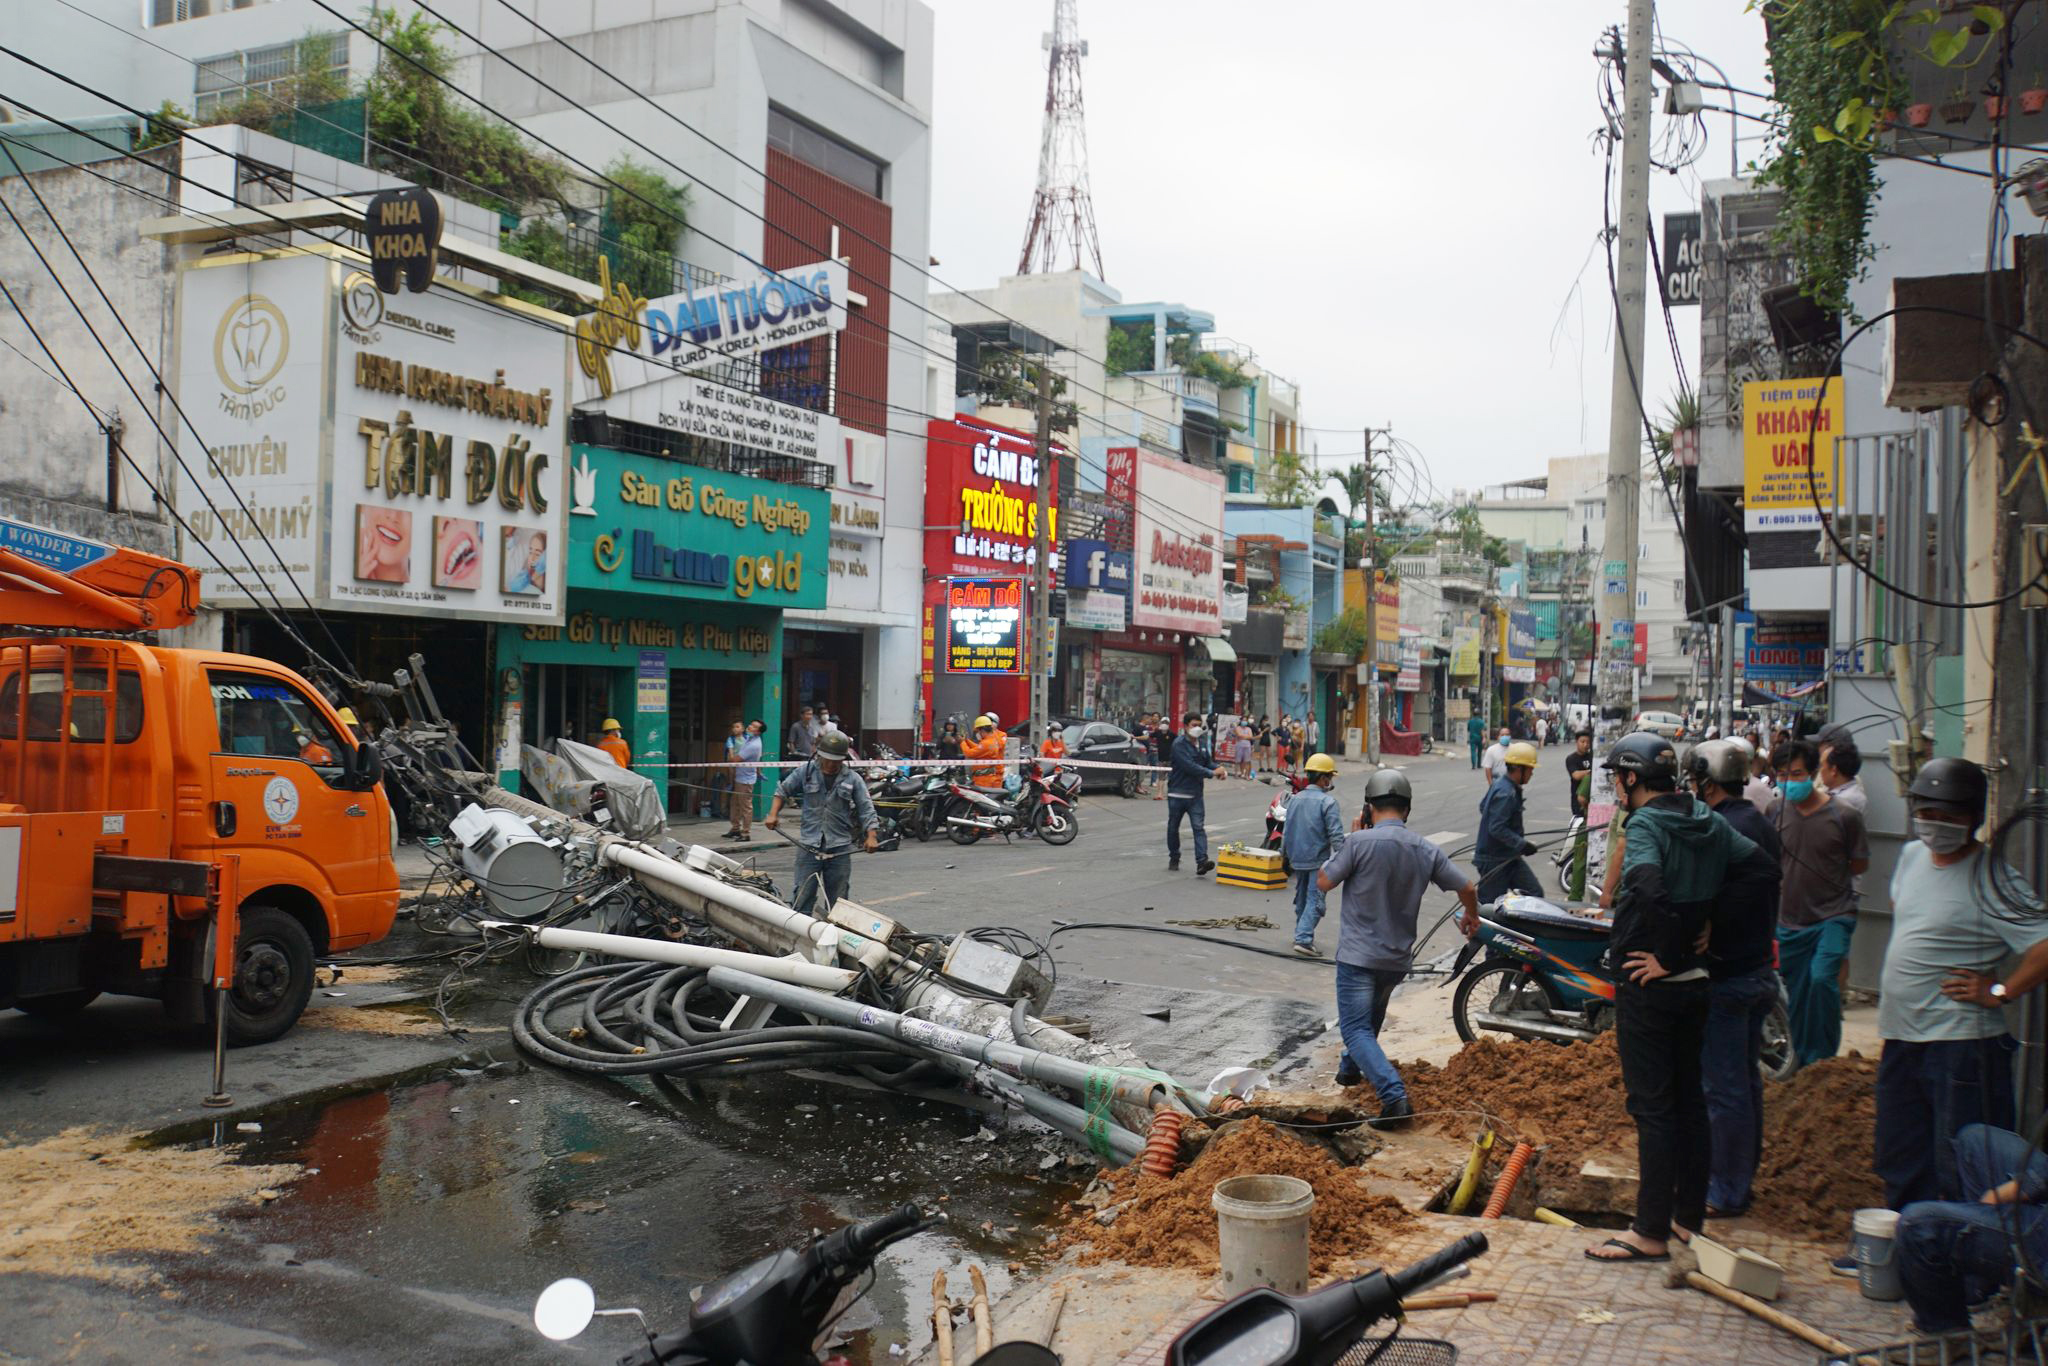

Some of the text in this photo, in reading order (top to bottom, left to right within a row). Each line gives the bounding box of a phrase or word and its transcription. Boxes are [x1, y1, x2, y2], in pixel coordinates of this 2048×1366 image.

[380, 200, 421, 226] NHA
[374, 232, 428, 259] KHOA
[671, 345, 708, 367] EURO
[717, 335, 760, 354] KOREA
[1756, 406, 1830, 435] KHÁNH
[207, 435, 287, 479] CHUYÊN
[358, 410, 550, 515] TÂM ĐỨC
[620, 470, 811, 536] Sàn Gỗ Công Nghiệp
[9, 527, 91, 560] WONDER 21
[734, 550, 803, 599] gold
[628, 619, 676, 647] Nhiên
[1749, 649, 1800, 665] LONG
